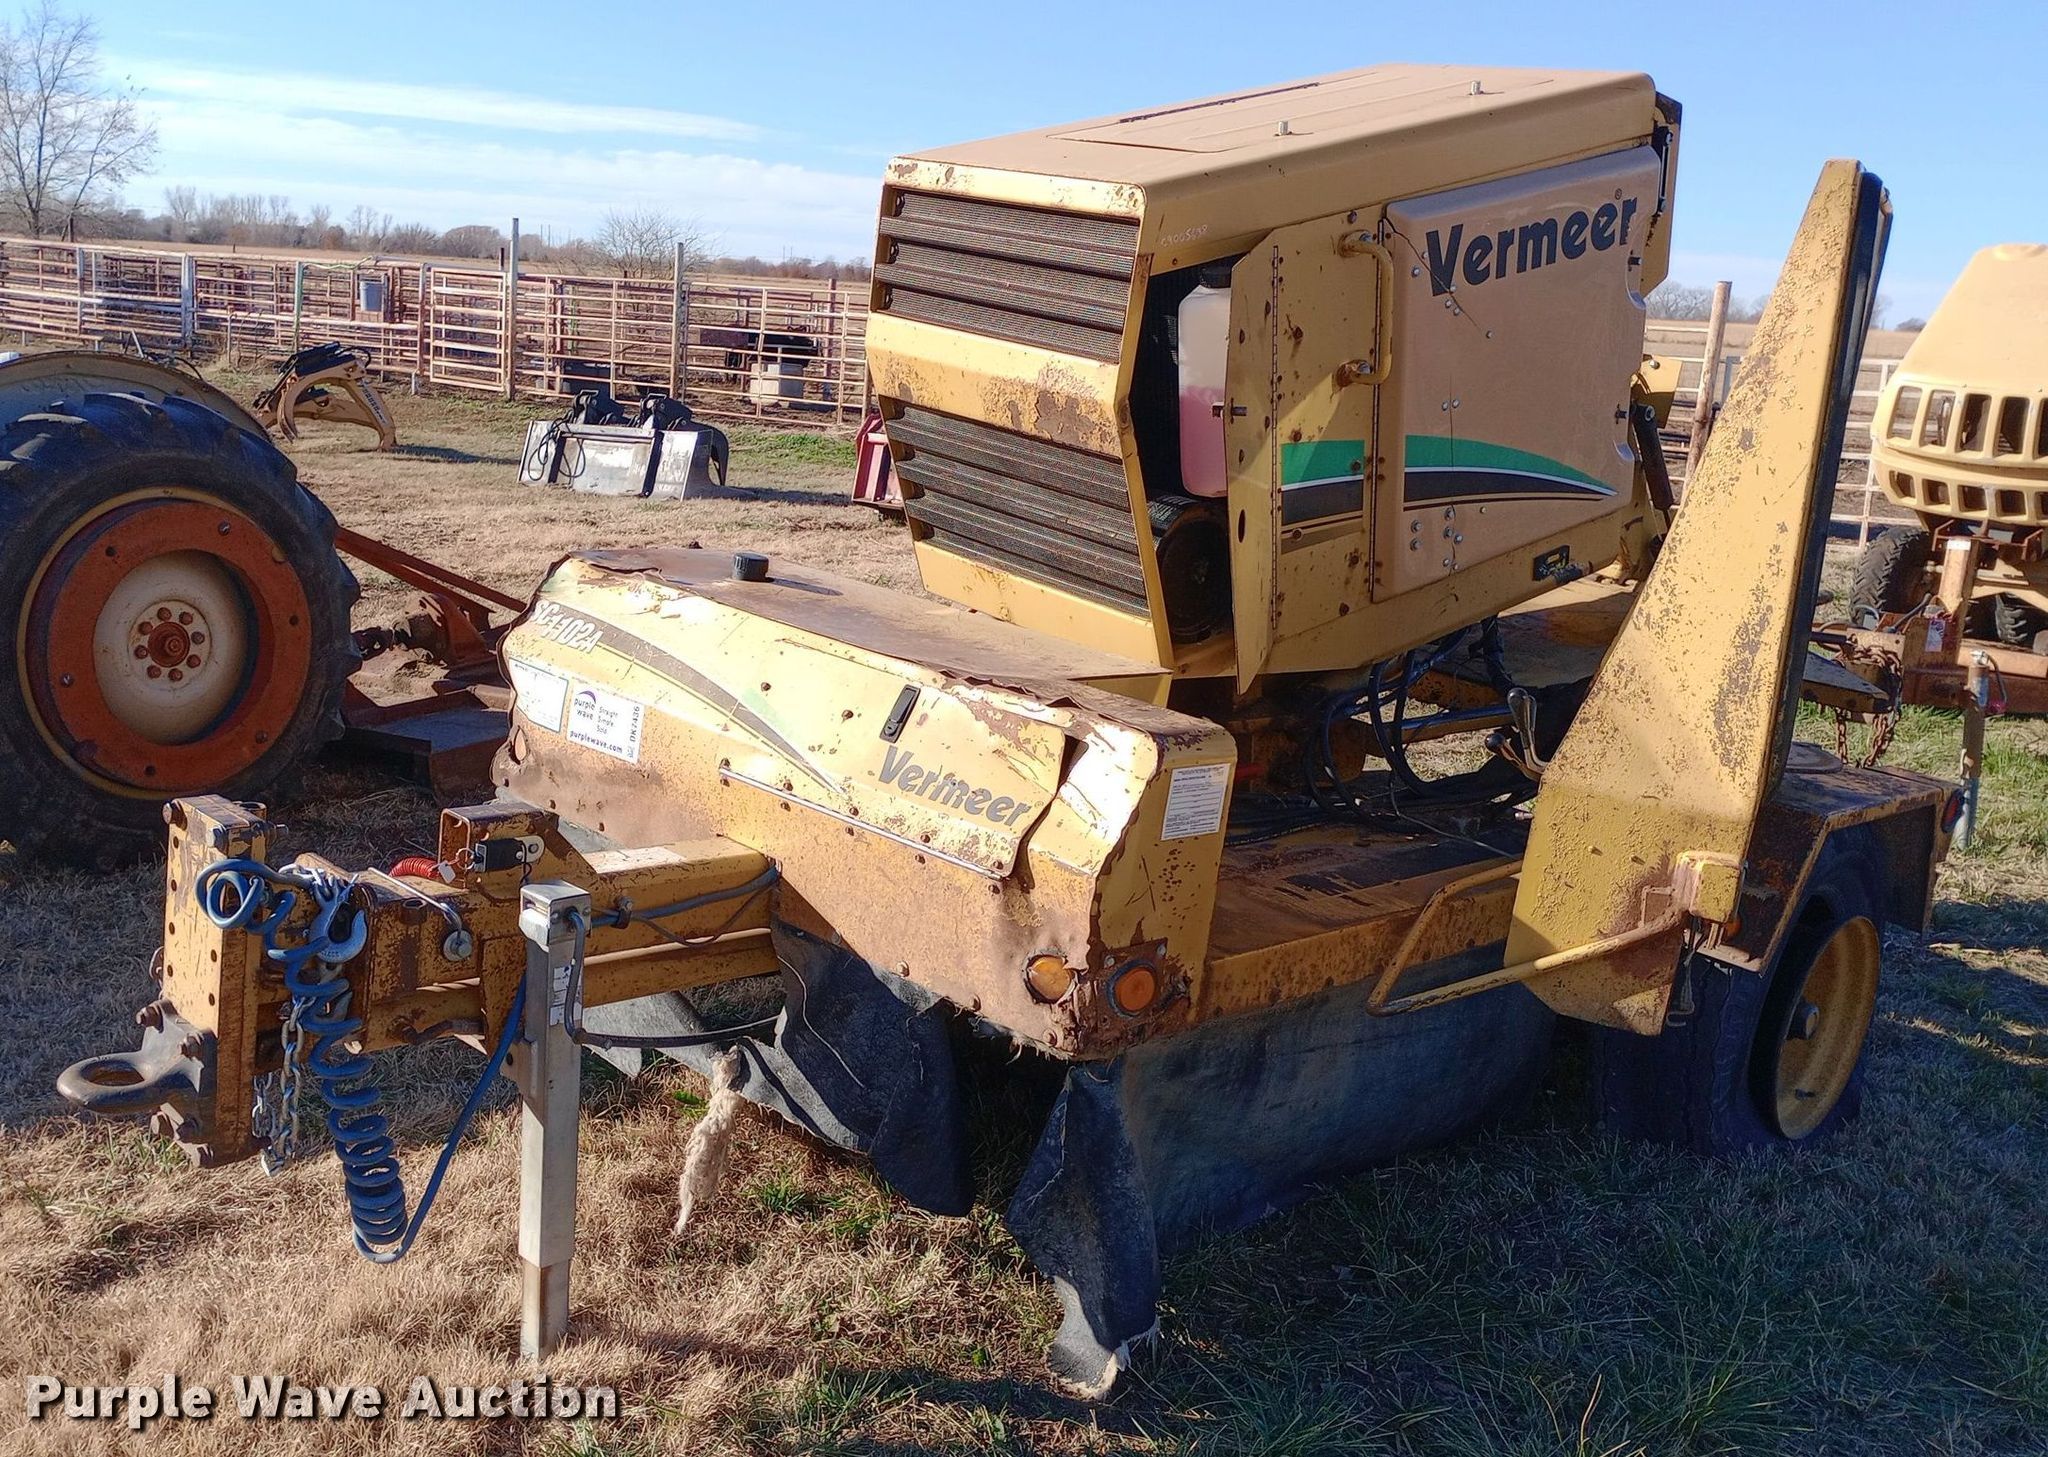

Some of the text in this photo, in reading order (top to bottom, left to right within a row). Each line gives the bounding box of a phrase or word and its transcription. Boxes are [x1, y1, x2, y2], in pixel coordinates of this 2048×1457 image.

[1425, 197, 1637, 297] Vermeer
[530, 600, 604, 654] SC1102A
[574, 698, 595, 711] purple
[577, 709, 593, 720] wave
[569, 730, 623, 754] purplewave.com
[878, 745, 1032, 827] Vermeer
